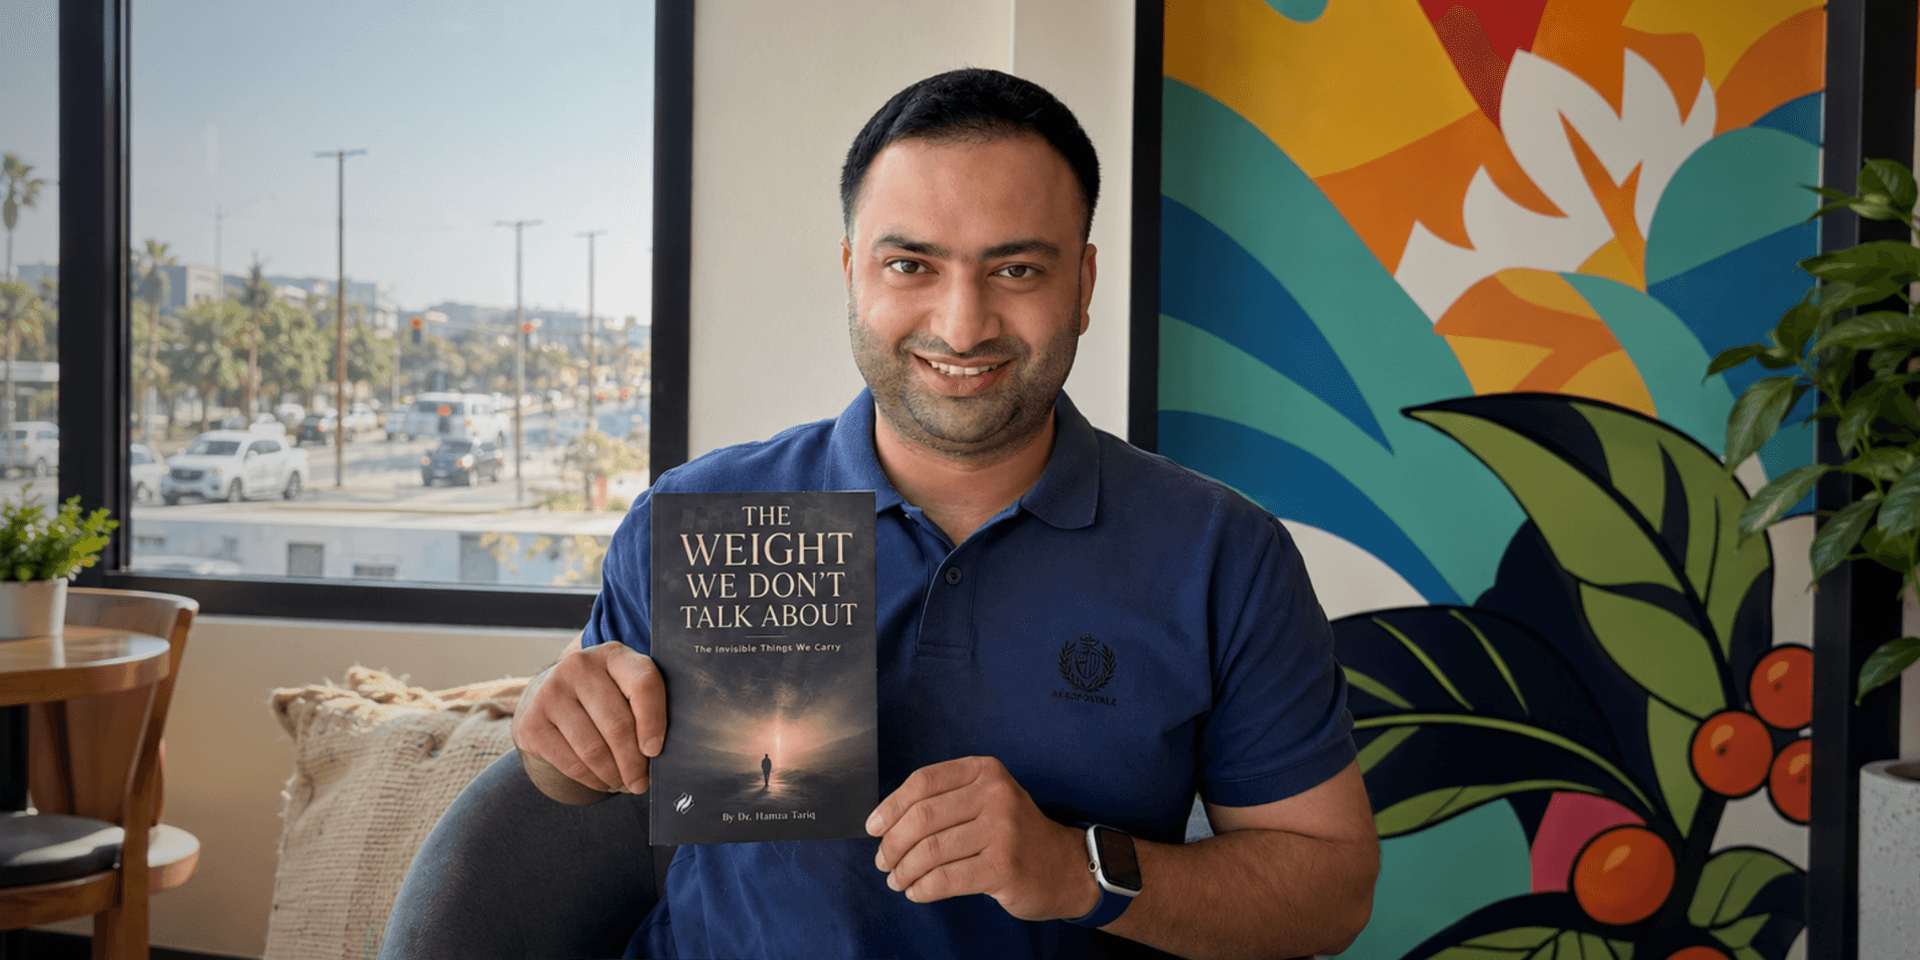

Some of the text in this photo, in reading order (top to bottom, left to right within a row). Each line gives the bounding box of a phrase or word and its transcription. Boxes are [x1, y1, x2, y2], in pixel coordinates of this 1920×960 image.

[742, 505, 791, 526] THE
[680, 532, 853, 566] WEIGHT
[686, 573, 737, 598] WE
[680, 603, 858, 629] TALK ABOUT
[694, 643, 841, 653] The Invisible Things We Carry
[722, 810, 816, 823] By Dr. Hamza Tariq
